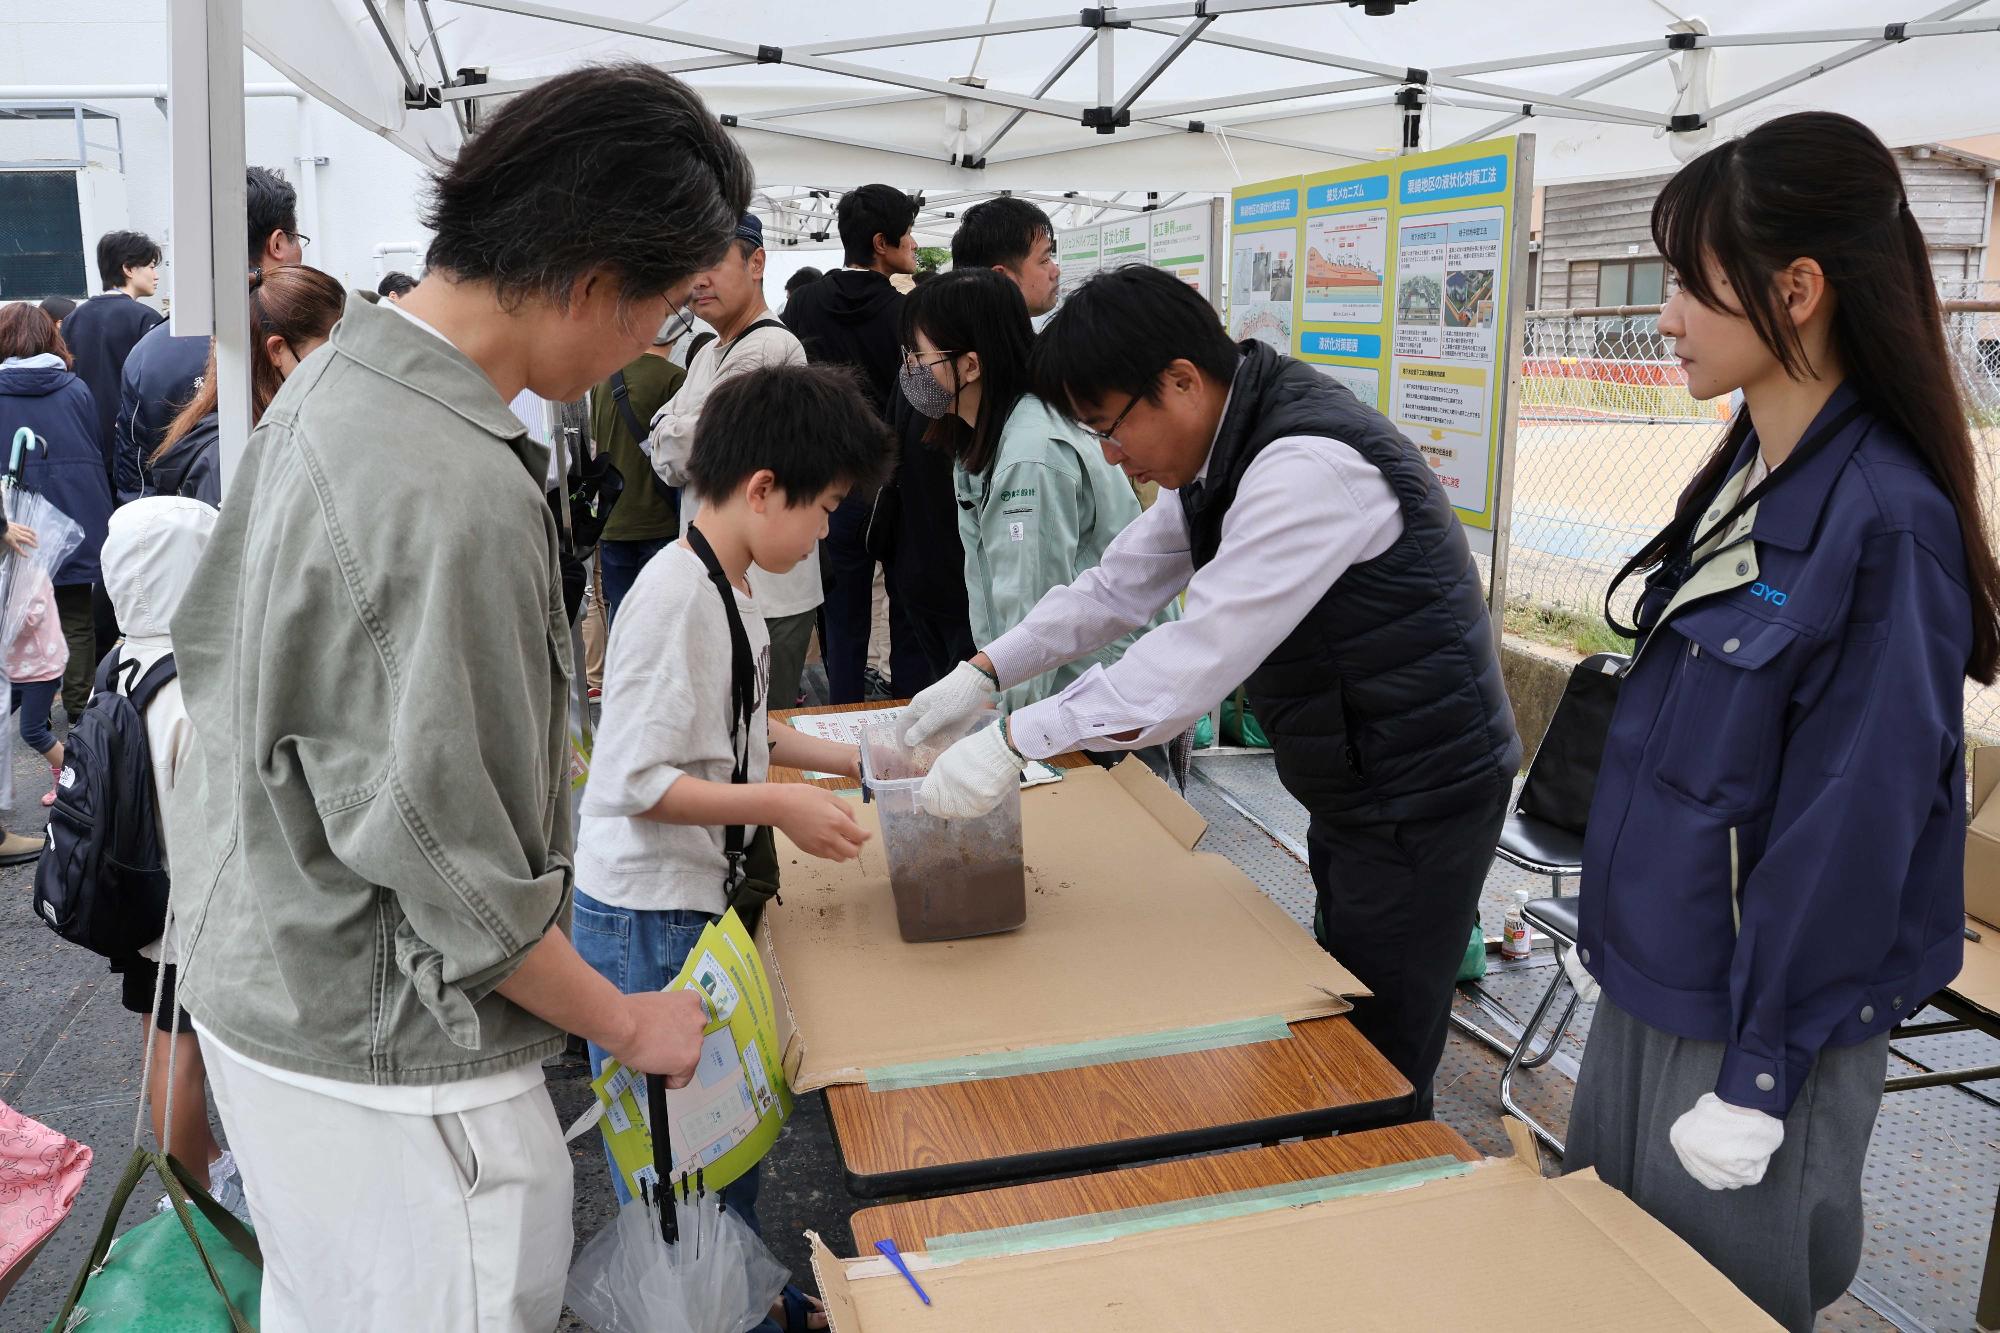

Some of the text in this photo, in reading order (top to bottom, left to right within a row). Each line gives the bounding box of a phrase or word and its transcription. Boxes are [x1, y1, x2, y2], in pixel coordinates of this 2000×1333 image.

[1326, 183, 1365, 203] 被災メカニズム
[1103, 227, 1130, 246] 液状化対策
[1318, 336, 1359, 353] 液状化対策範囲
[1750, 582, 1787, 606] OYO
